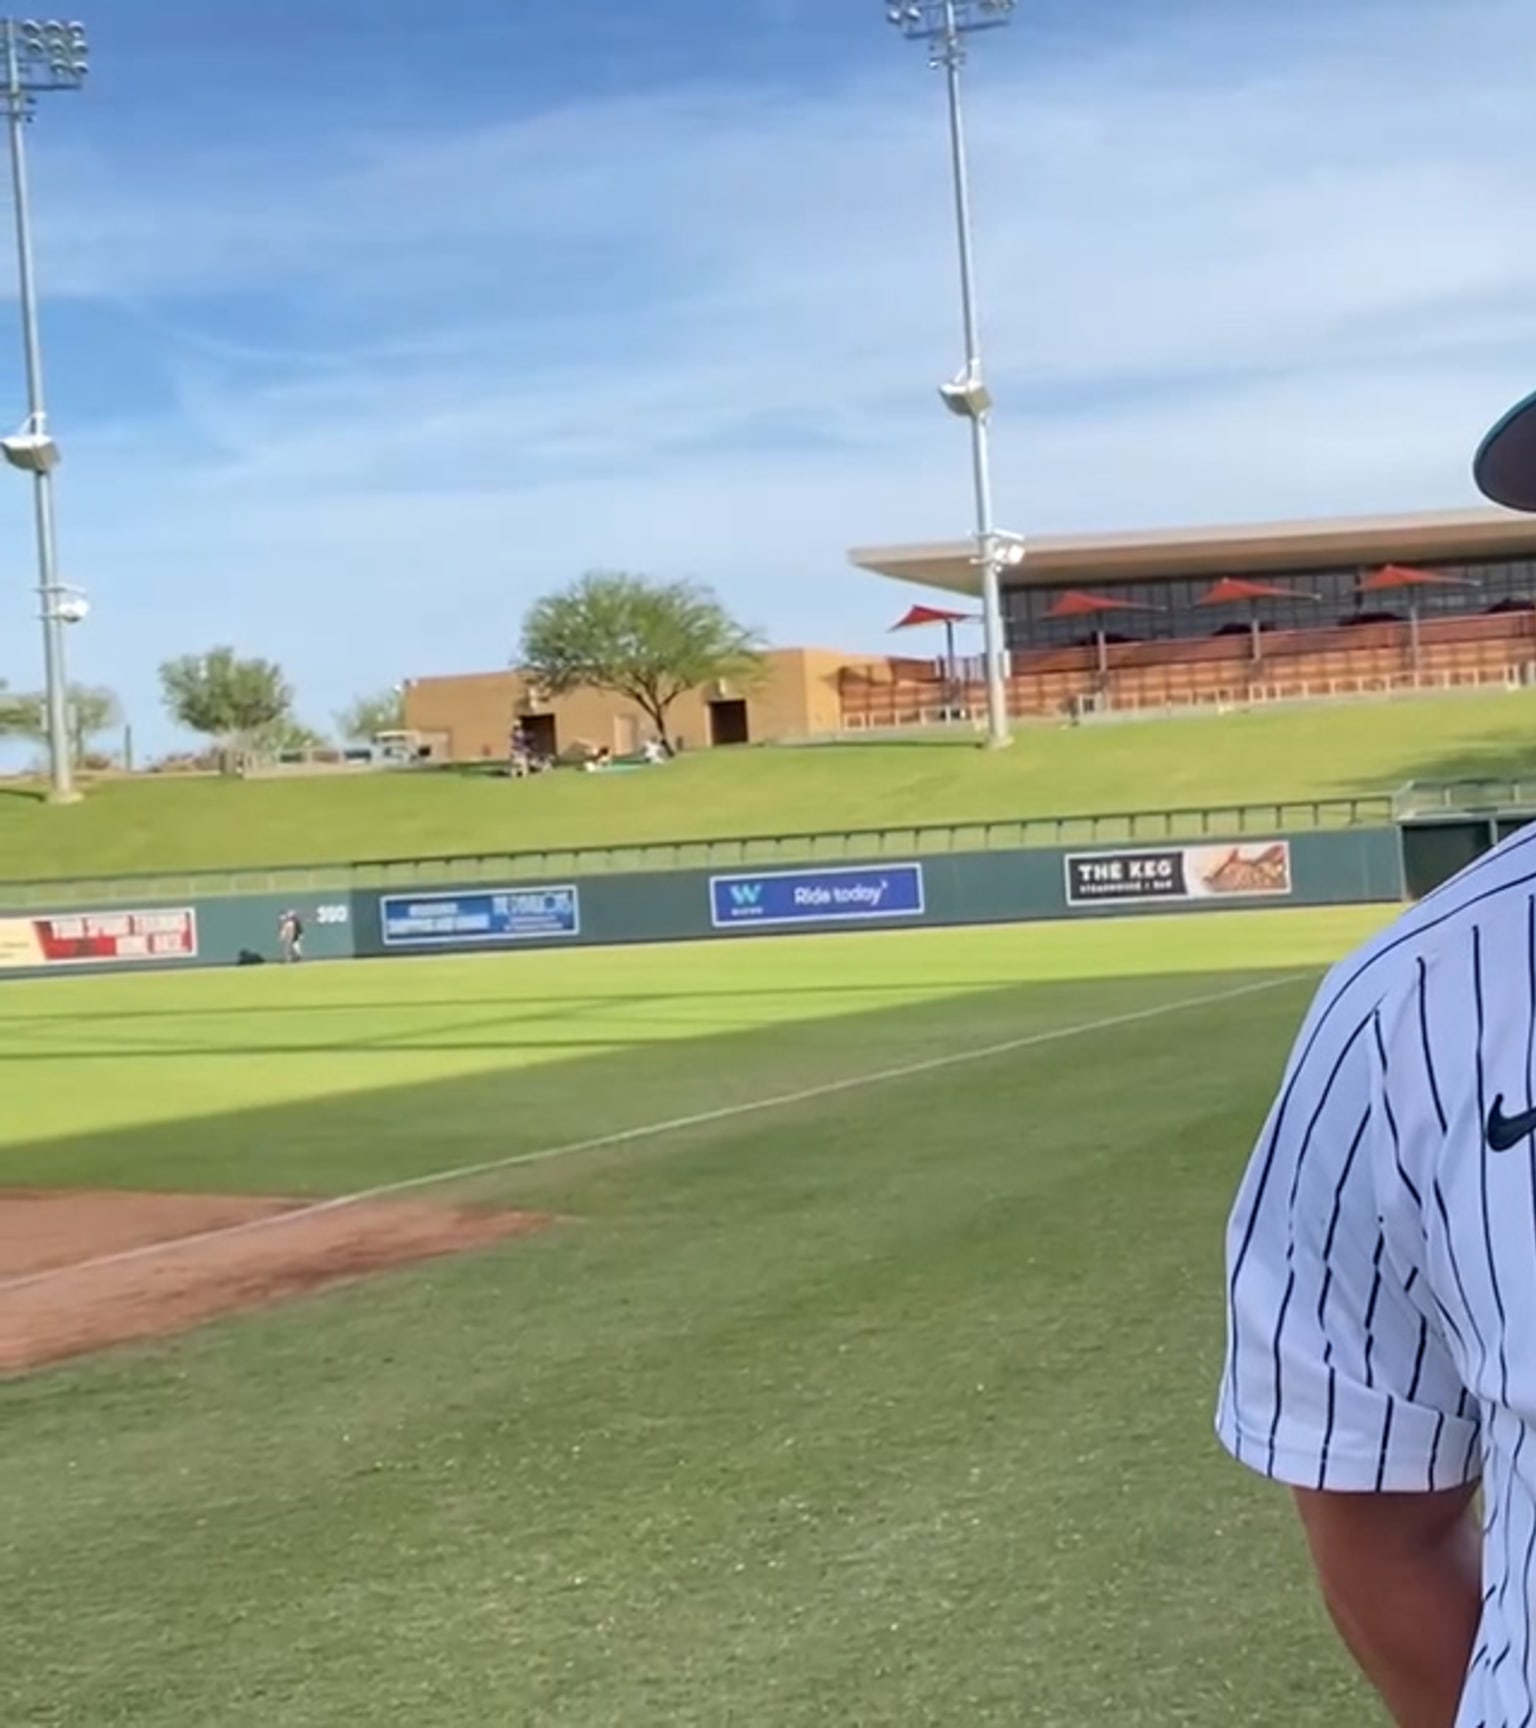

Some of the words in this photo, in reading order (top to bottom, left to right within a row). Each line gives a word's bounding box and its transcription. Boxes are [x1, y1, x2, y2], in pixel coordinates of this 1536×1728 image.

[1078, 862, 1122, 881] THE
[1129, 859, 1172, 879] KEG
[793, 886, 831, 905] Ride
